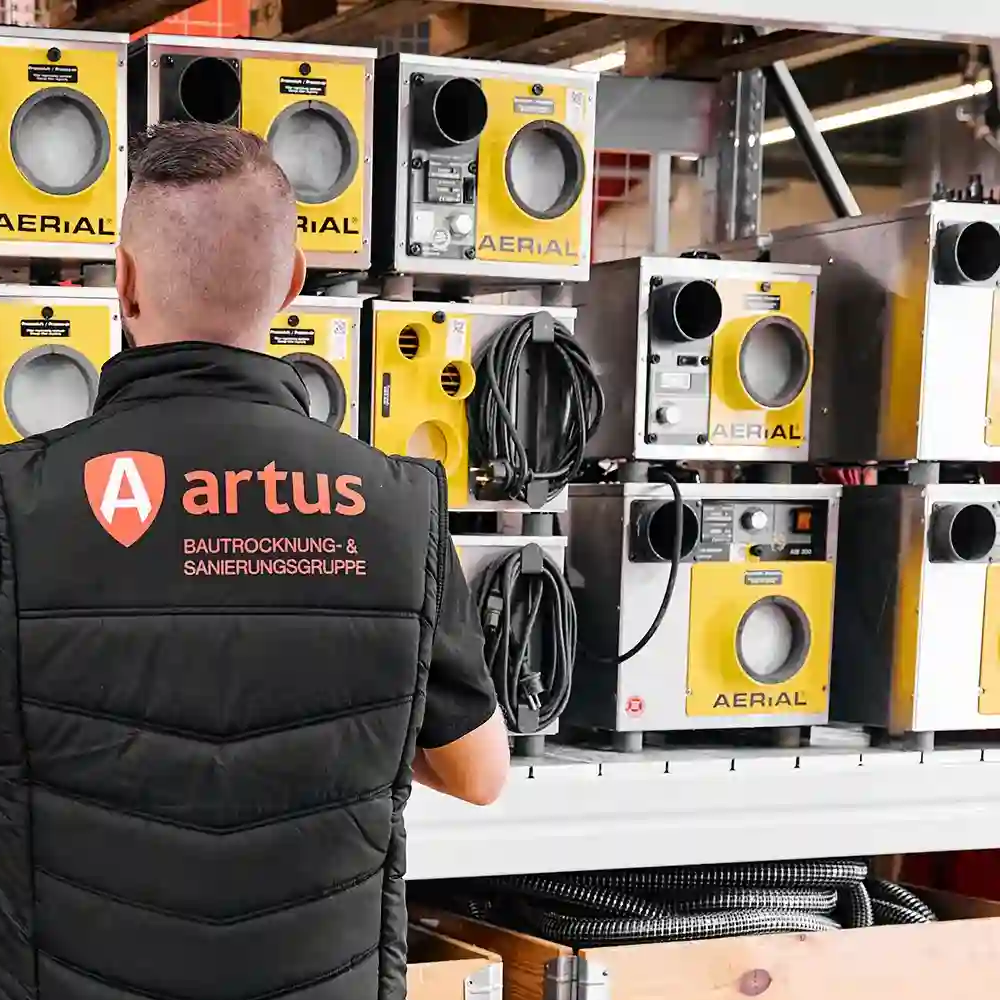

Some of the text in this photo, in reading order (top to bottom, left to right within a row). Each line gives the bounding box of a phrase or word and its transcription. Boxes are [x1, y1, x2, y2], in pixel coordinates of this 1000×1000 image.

[182, 460, 367, 516] artus
[183, 537, 358, 555] BAUTROCKNUNG- &
[183, 558, 368, 576] SANIERUNGSGRUPPE
